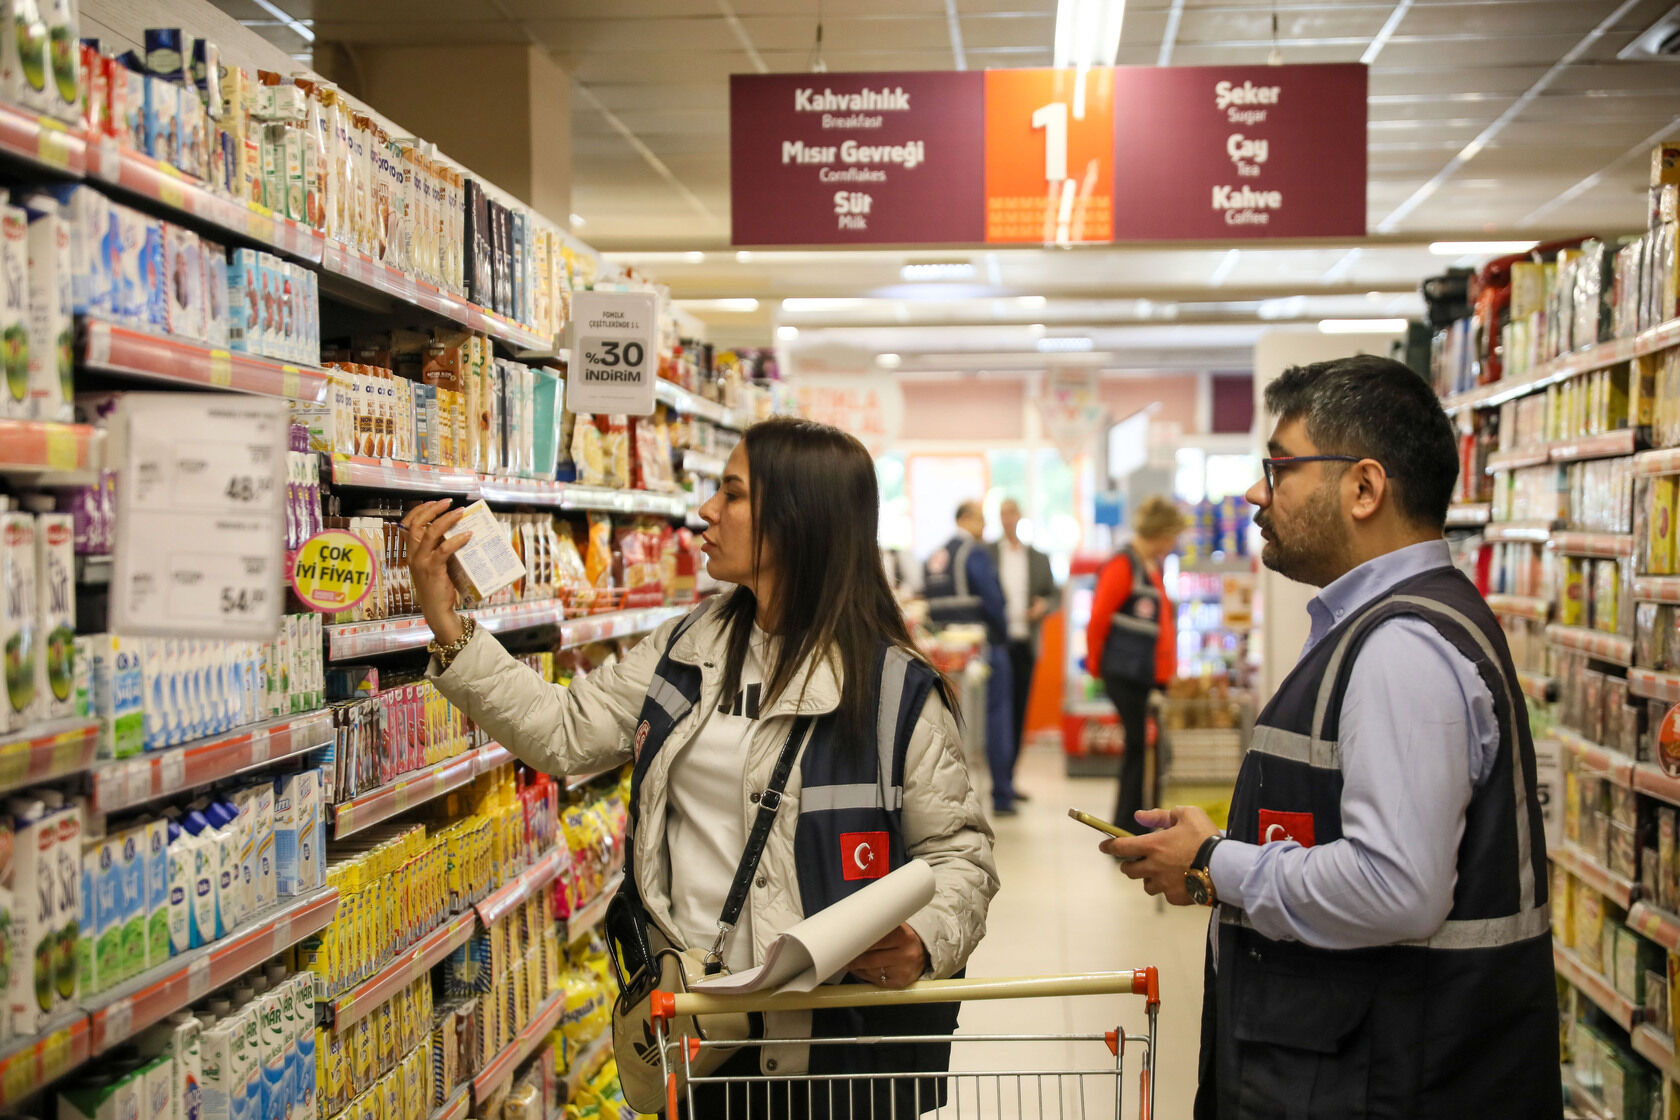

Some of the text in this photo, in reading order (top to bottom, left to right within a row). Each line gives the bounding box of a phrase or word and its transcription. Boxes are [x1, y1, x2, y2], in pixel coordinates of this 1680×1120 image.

[794, 87, 911, 112] Kahvaltılık
[1215, 79, 1281, 110] Şeker
[821, 113, 883, 129] Breakfast
[1227, 106, 1267, 125] Sugar
[1031, 101, 1068, 182] 1
[1226, 132, 1269, 164] Çay
[782, 139, 925, 169] Mısır Gevreği
[819, 166, 888, 183] Cornflakes
[1237, 160, 1260, 177] Tea
[833, 190, 874, 214] Süt
[1211, 184, 1283, 210] Kahve
[838, 214, 868, 230] Milk
[1224, 208, 1270, 225] Coffee
[585, 341, 644, 367] %30
[319, 545, 353, 562] ÇOK
[296, 560, 370, 586] İYİ FİYAT!
